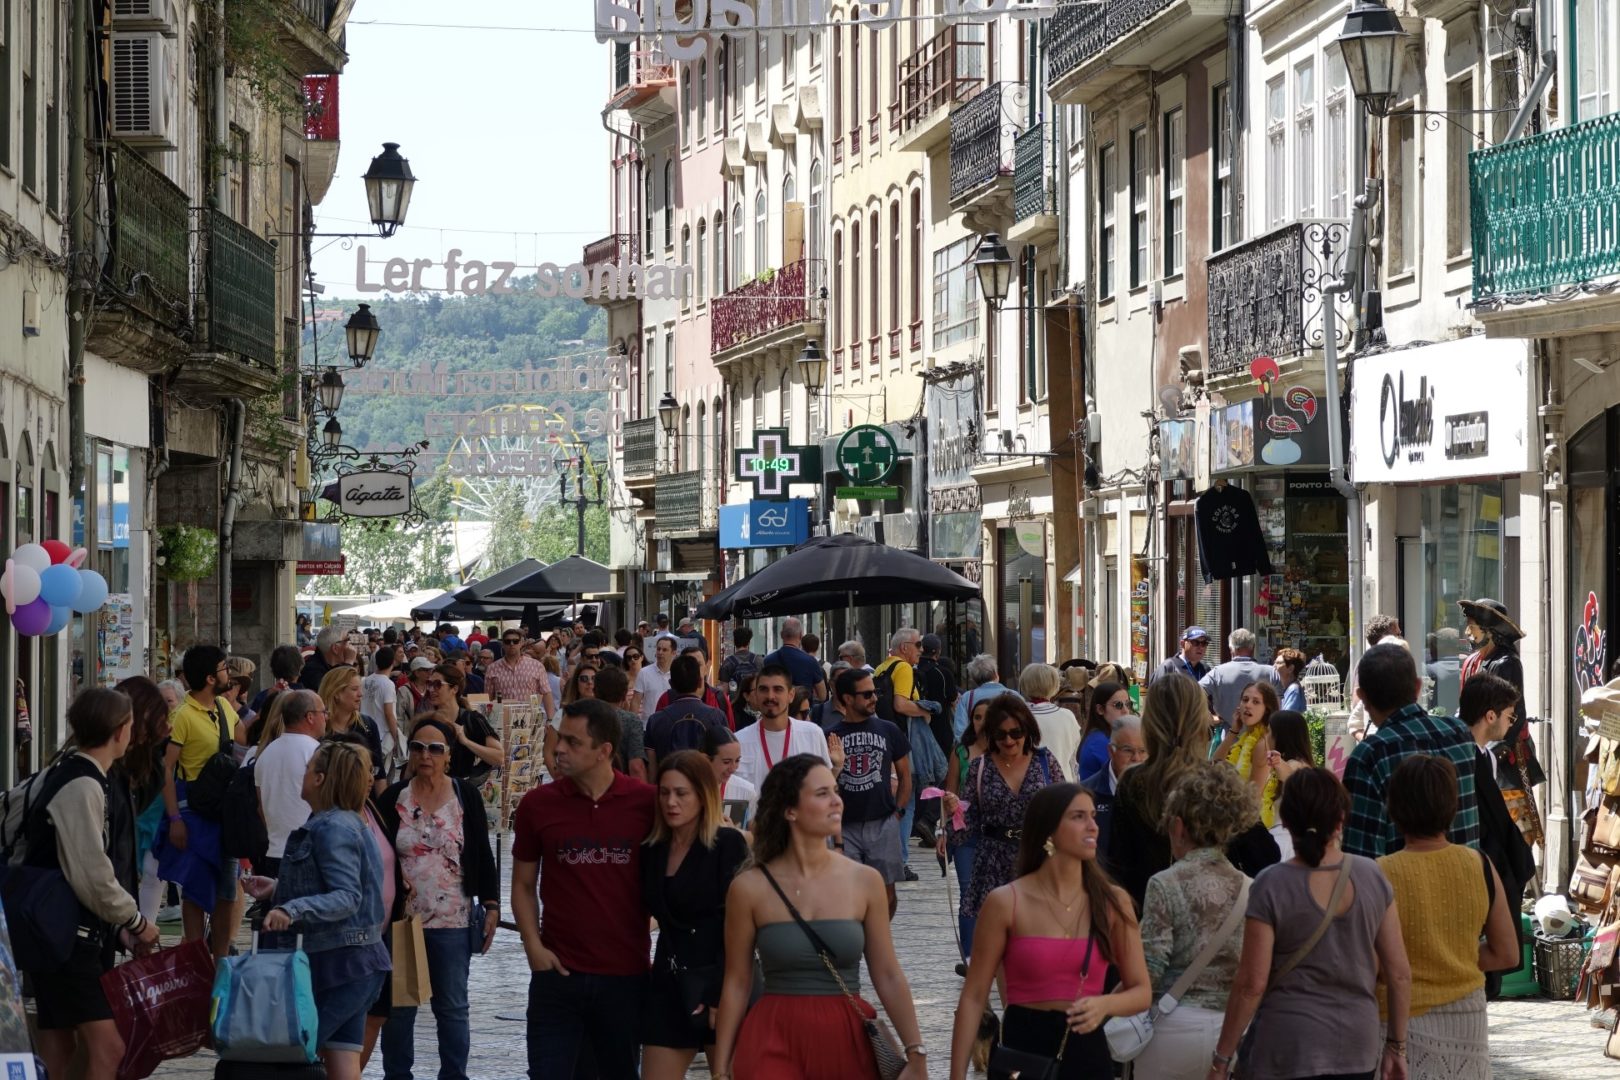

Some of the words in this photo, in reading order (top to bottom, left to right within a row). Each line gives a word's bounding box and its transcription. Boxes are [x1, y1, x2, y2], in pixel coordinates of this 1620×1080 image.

[356, 244, 433, 293] Ler
[443, 248, 516, 298] faz
[535, 251, 694, 300] sonhar
[750, 458, 790, 472] 10:49
[841, 731, 888, 752] STERDAM
[844, 781, 874, 792] HOLLAND
